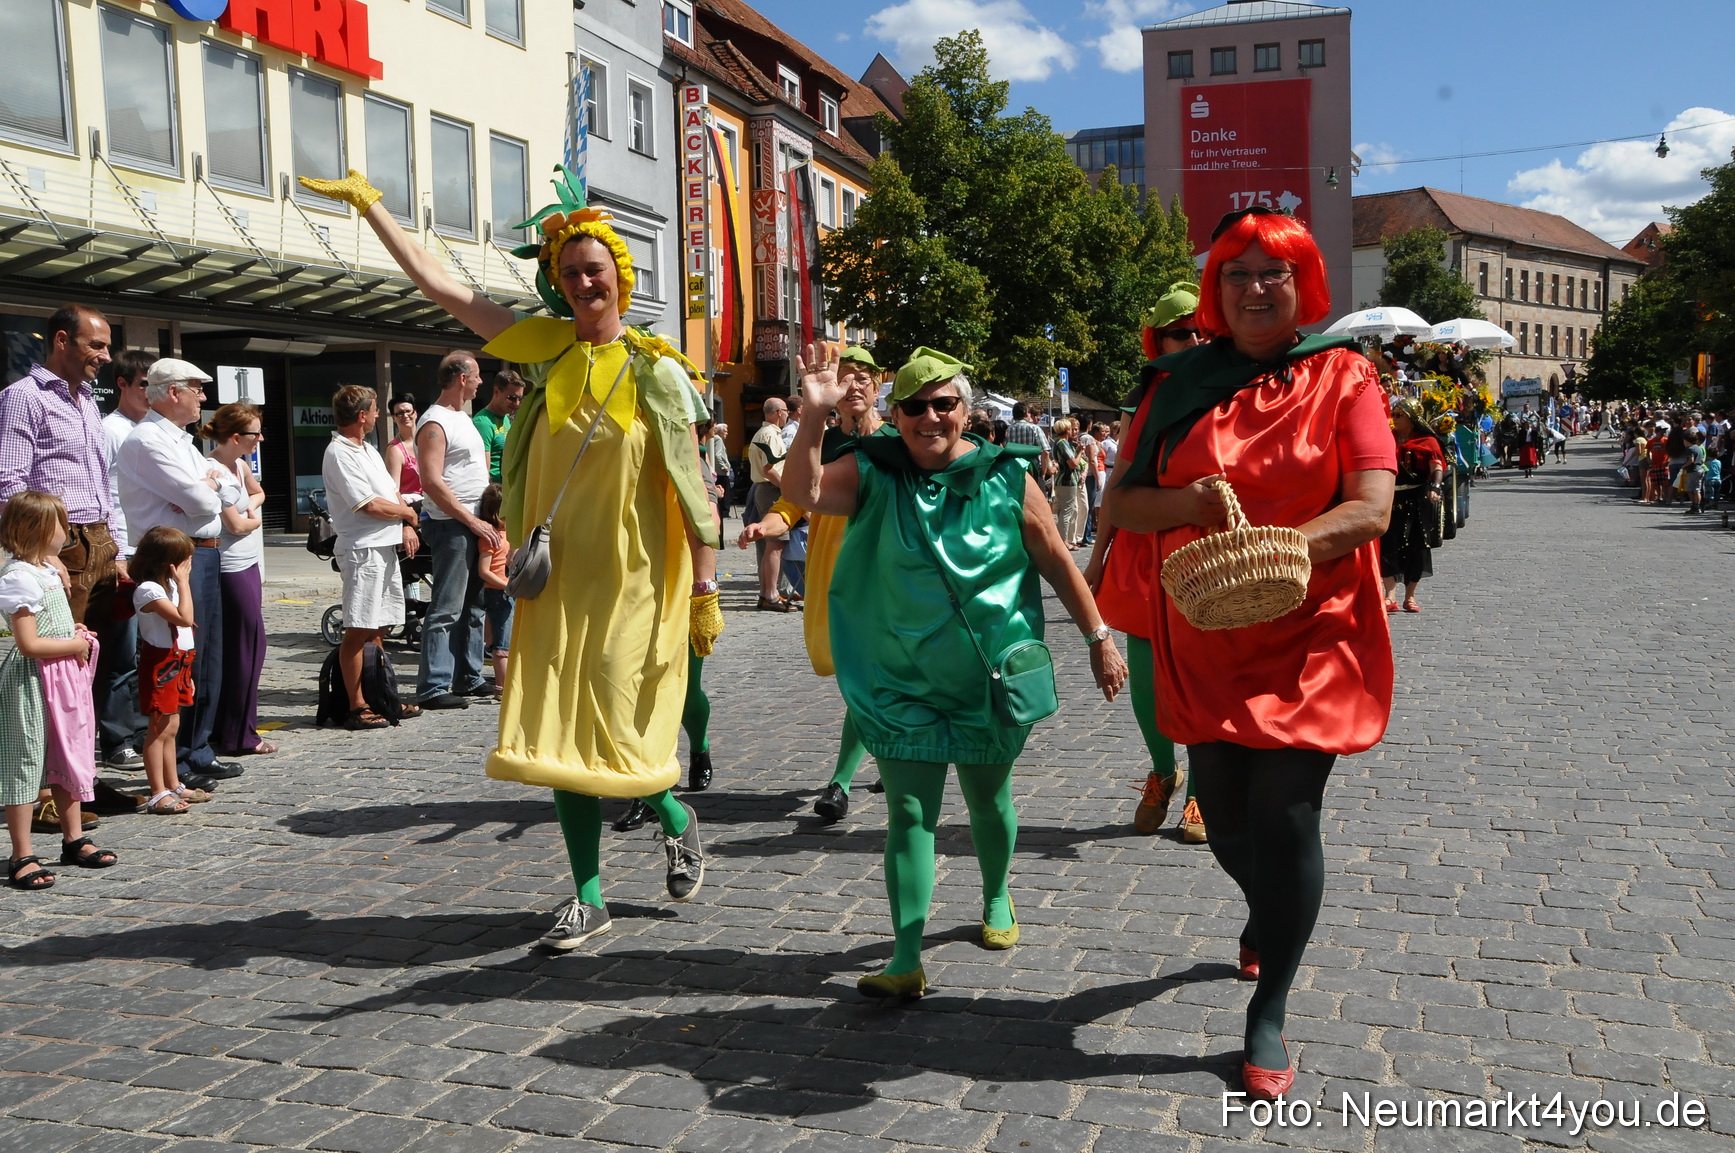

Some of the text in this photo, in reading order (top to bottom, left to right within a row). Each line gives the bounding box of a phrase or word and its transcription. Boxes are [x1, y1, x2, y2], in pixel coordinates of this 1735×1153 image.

[1191, 128, 1237, 143] Danke
[1190, 147, 1267, 158] für Ihr Vertrauen
[1191, 160, 1260, 170] und Ihre Treue.
[685, 87, 704, 270] BÄCKEREI
[1229, 190, 1272, 210] 175
[689, 278, 704, 291] caf
[300, 408, 334, 425] Aktion
